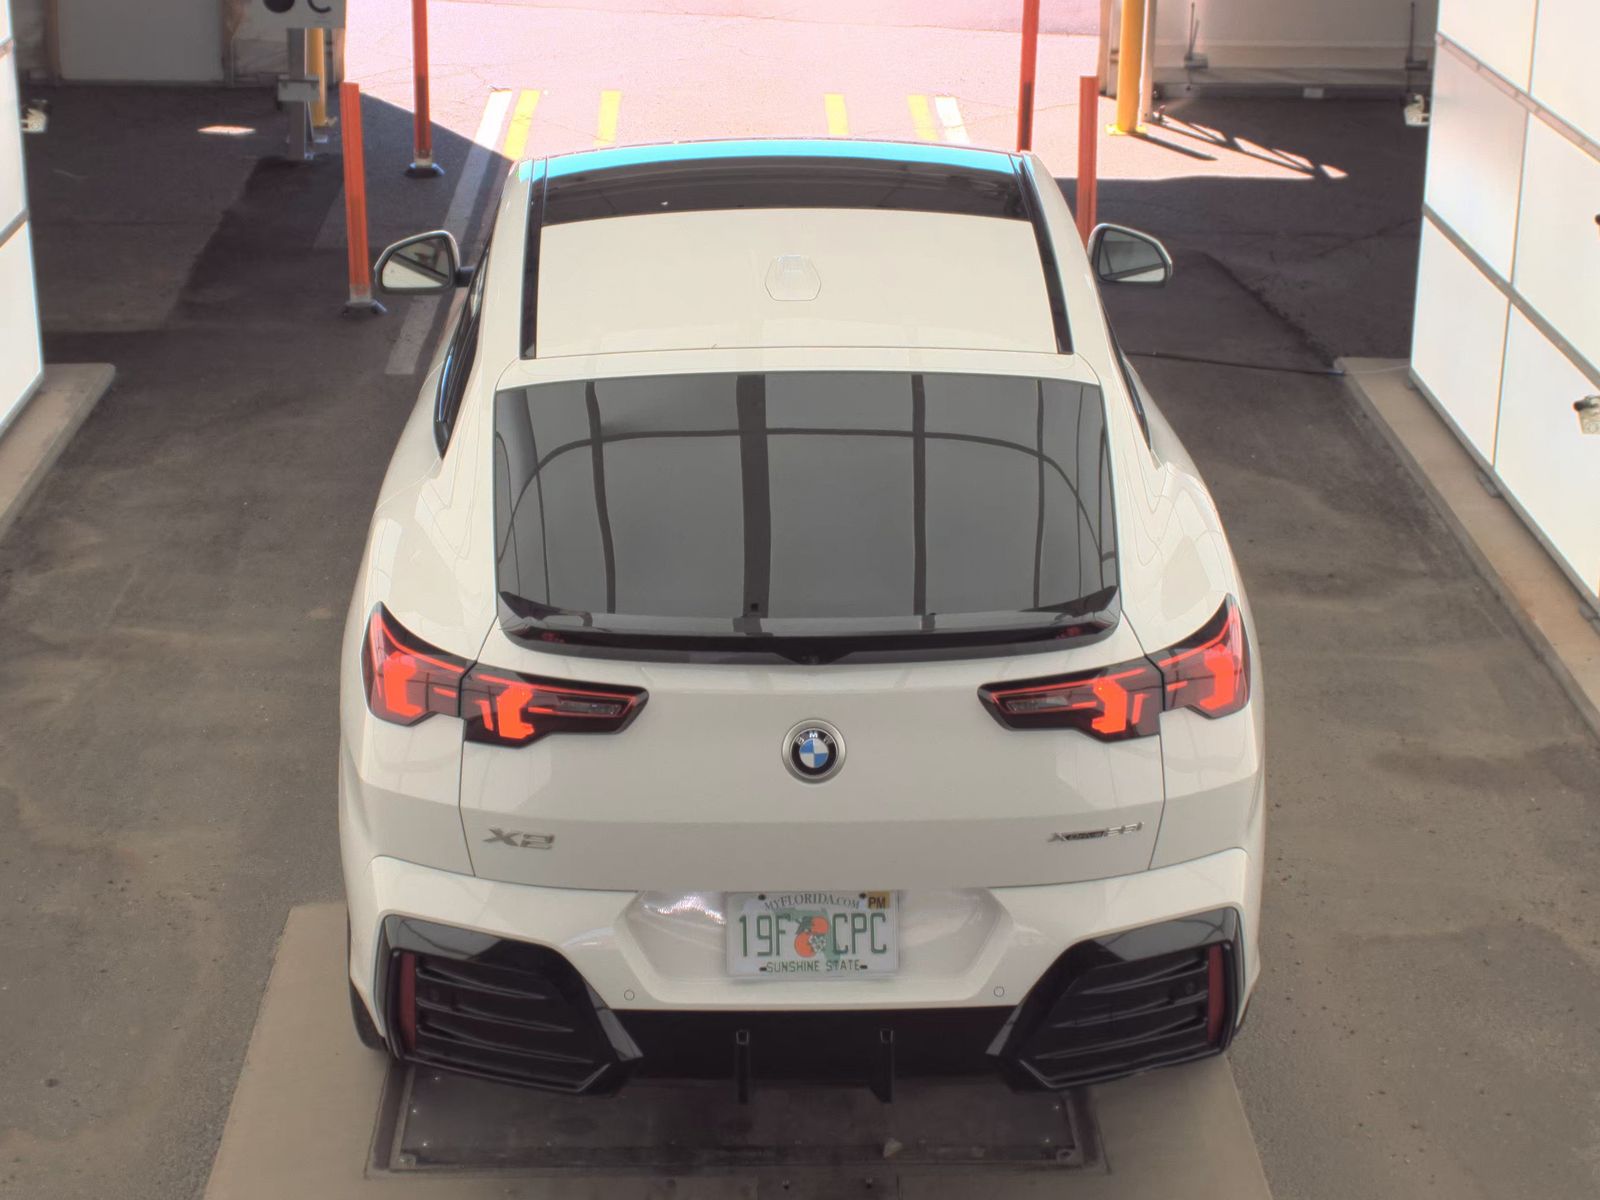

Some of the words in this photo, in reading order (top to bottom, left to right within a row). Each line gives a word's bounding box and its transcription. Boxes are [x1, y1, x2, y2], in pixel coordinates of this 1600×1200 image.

[796, 732, 832, 745] BMW
[765, 893, 860, 912] MYFLORIDA.COM
[868, 896, 886, 909] PM
[739, 913, 791, 957] 19F
[832, 912, 887, 954] CPC
[766, 961, 820, 973] SUNSHINE
[826, 959, 861, 971] STATE
